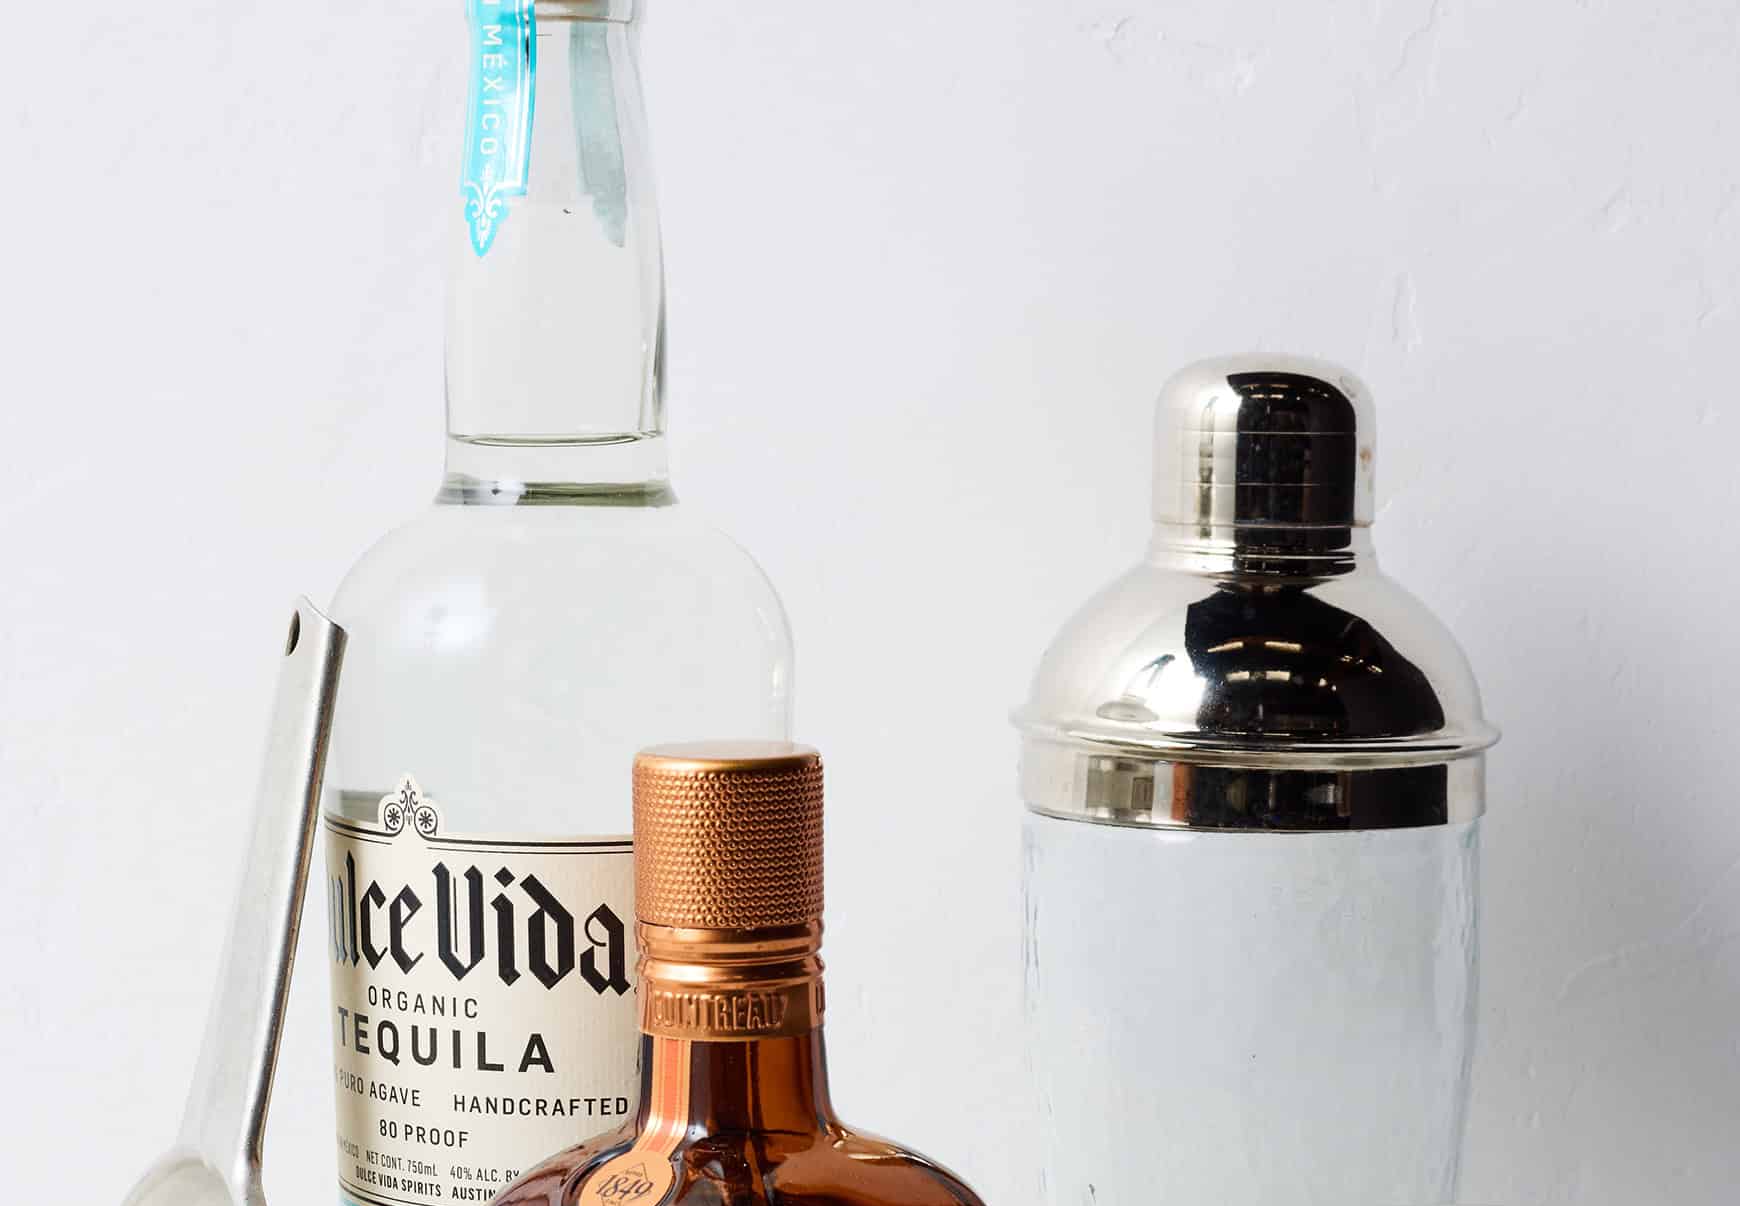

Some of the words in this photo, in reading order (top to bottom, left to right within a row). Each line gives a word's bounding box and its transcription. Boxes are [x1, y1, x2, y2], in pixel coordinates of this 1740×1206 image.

[328, 850, 425, 975] ulce
[432, 860, 631, 996] Vida
[367, 985, 479, 1019] ORGANIC
[337, 1006, 556, 1074] TEQUILA
[339, 1068, 364, 1095] PURO
[369, 1080, 421, 1108] AGAVE
[453, 1094, 628, 1117] HANDCRAFTED
[379, 1119, 398, 1139] 80
[404, 1124, 469, 1149] PROOF
[355, 1165, 377, 1184] DULCE
[378, 1173, 399, 1190] VIDA
[401, 1178, 442, 1197] SPIRITS
[366, 1149, 379, 1166] NET
[381, 1154, 405, 1172] CONT.
[407, 1160, 439, 1177] 750mL
[450, 1165, 473, 1181] 40%
[476, 1169, 502, 1183] ALC.
